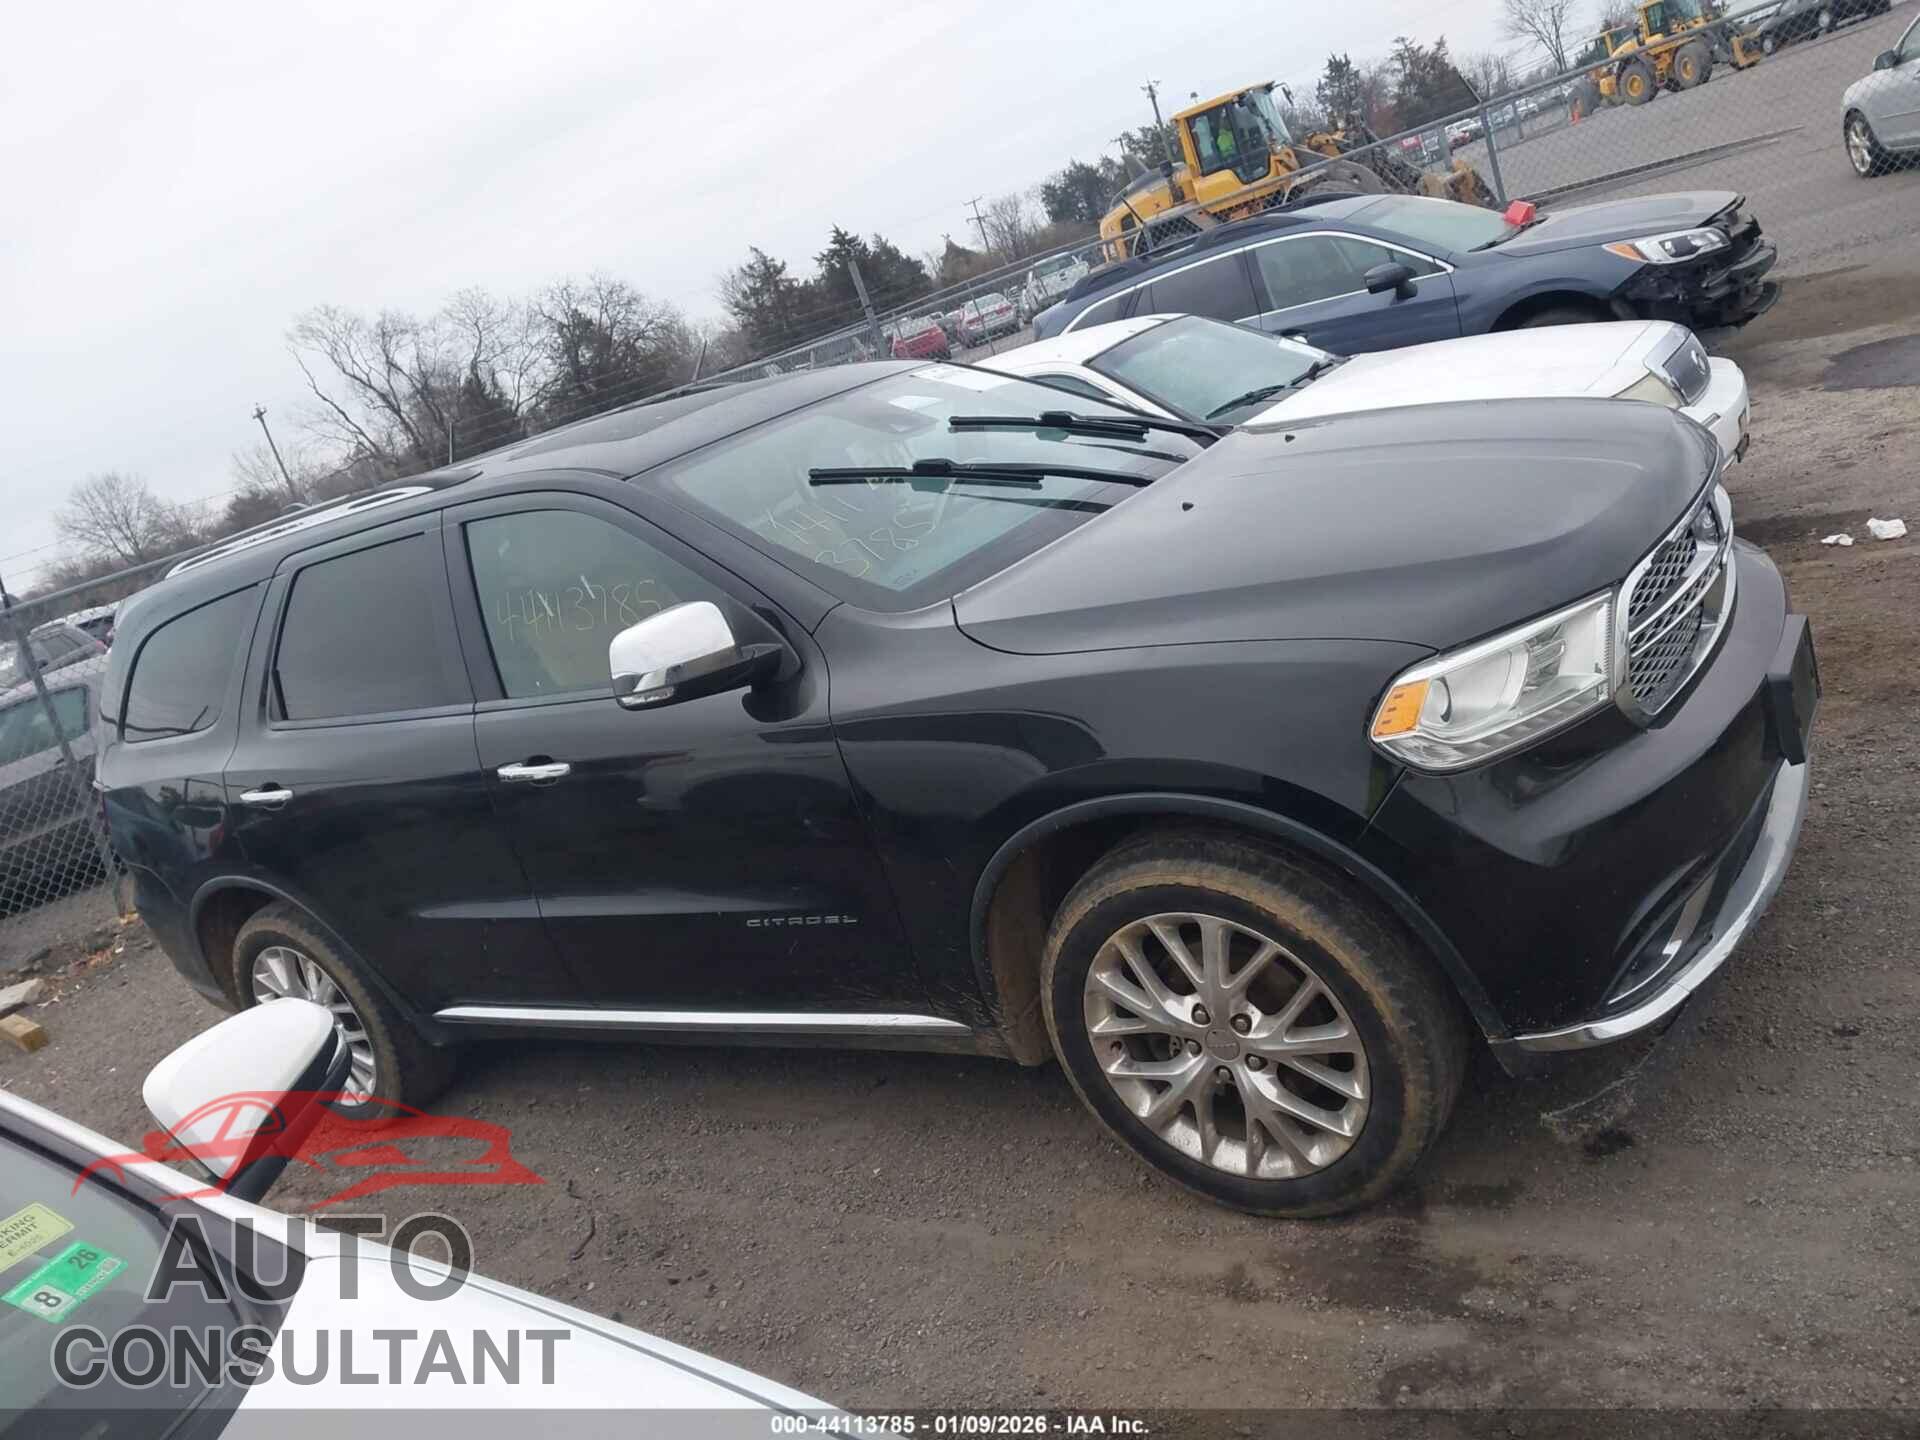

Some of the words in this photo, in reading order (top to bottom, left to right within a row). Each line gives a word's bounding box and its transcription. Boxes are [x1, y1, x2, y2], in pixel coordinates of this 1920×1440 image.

[746, 914, 857, 928] CITADEL
[0, 1214, 36, 1239] KING
[67, 1249, 97, 1270] 26
[34, 1291, 62, 1308] 8
